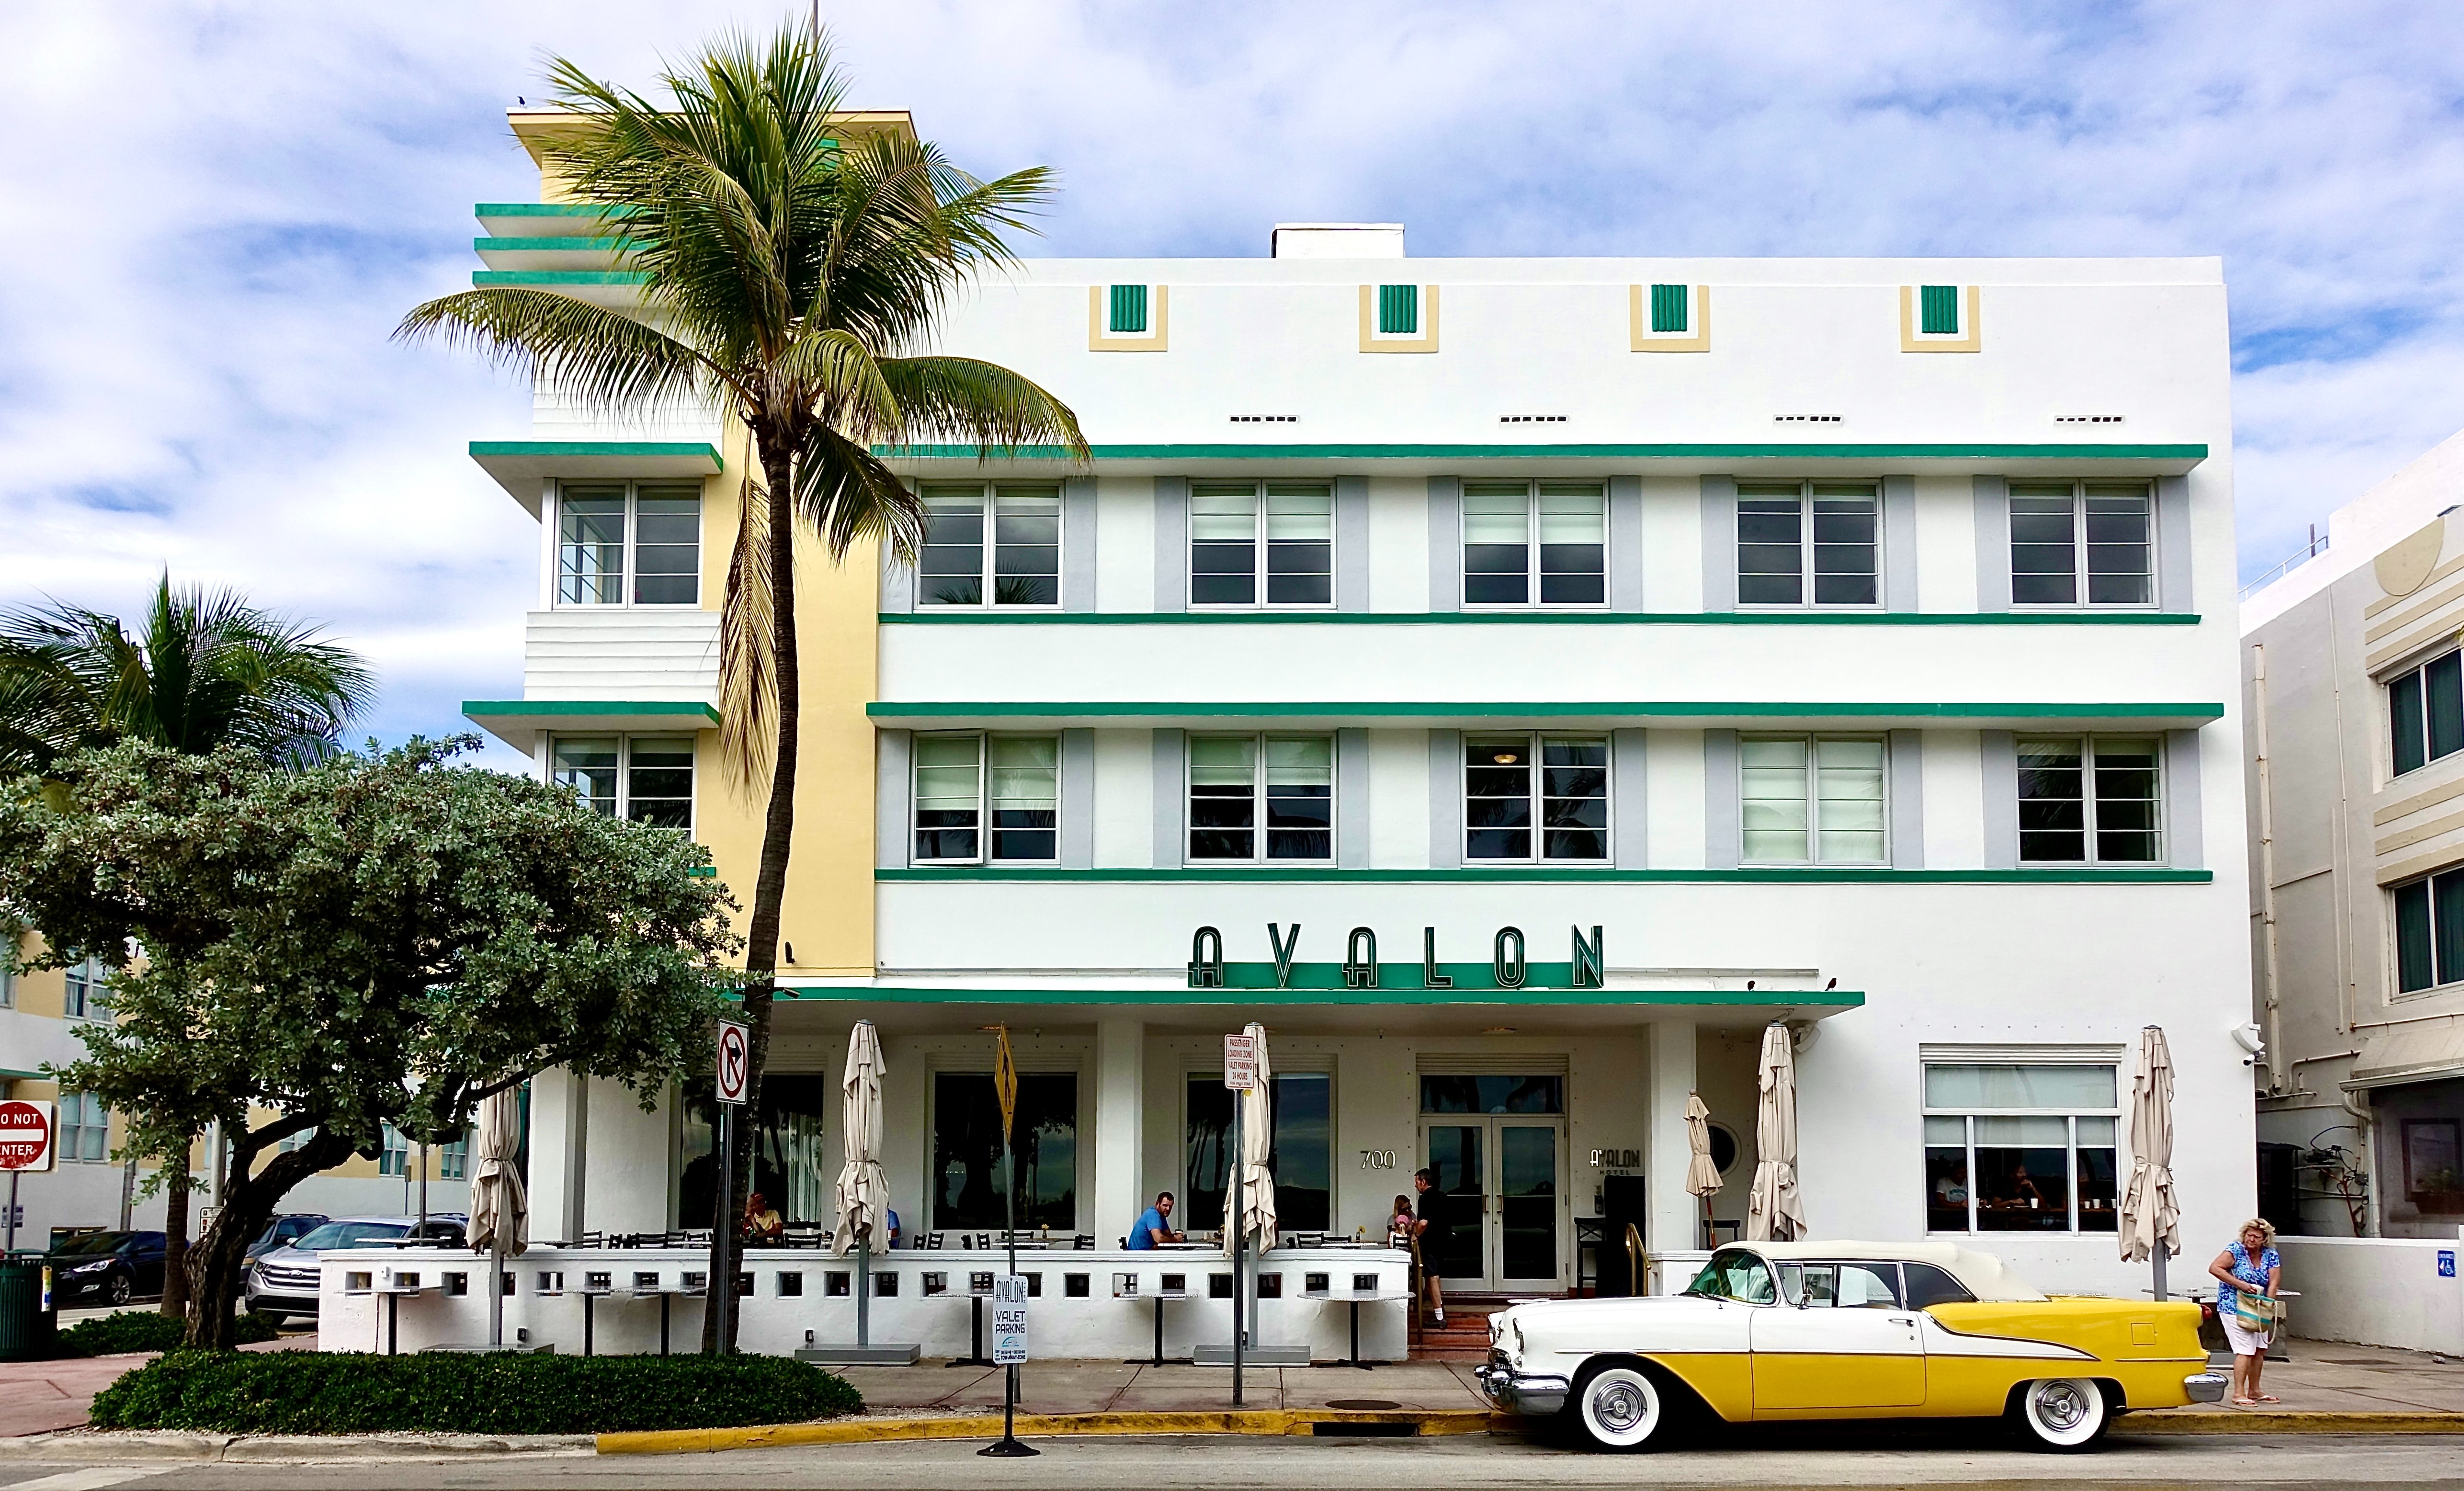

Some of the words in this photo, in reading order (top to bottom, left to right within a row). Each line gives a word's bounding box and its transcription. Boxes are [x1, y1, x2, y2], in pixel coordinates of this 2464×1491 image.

[1188, 922, 1604, 988] AVALON
[1229, 1039, 1250, 1048] PASSENGER
[1228, 1049, 1242, 1058] LOADING
[1243, 1050, 1252, 1059] ZONE
[1228, 1061, 1238, 1069] VALET
[1238, 1062, 1252, 1071] PARKING
[1233, 1072, 1237, 1080] 24
[1237, 1072, 1248, 1080] HOURS
[0, 1114, 8, 1124] O
[14, 1113, 38, 1124] NOT
[0, 1145, 33, 1155] NTER
[1361, 1150, 1396, 1169] 700
[1590, 1149, 1640, 1167] AVALON
[996, 1280, 1023, 1303] AVALON
[996, 1310, 1025, 1322] VALET
[996, 1323, 1025, 1333] PARKING
